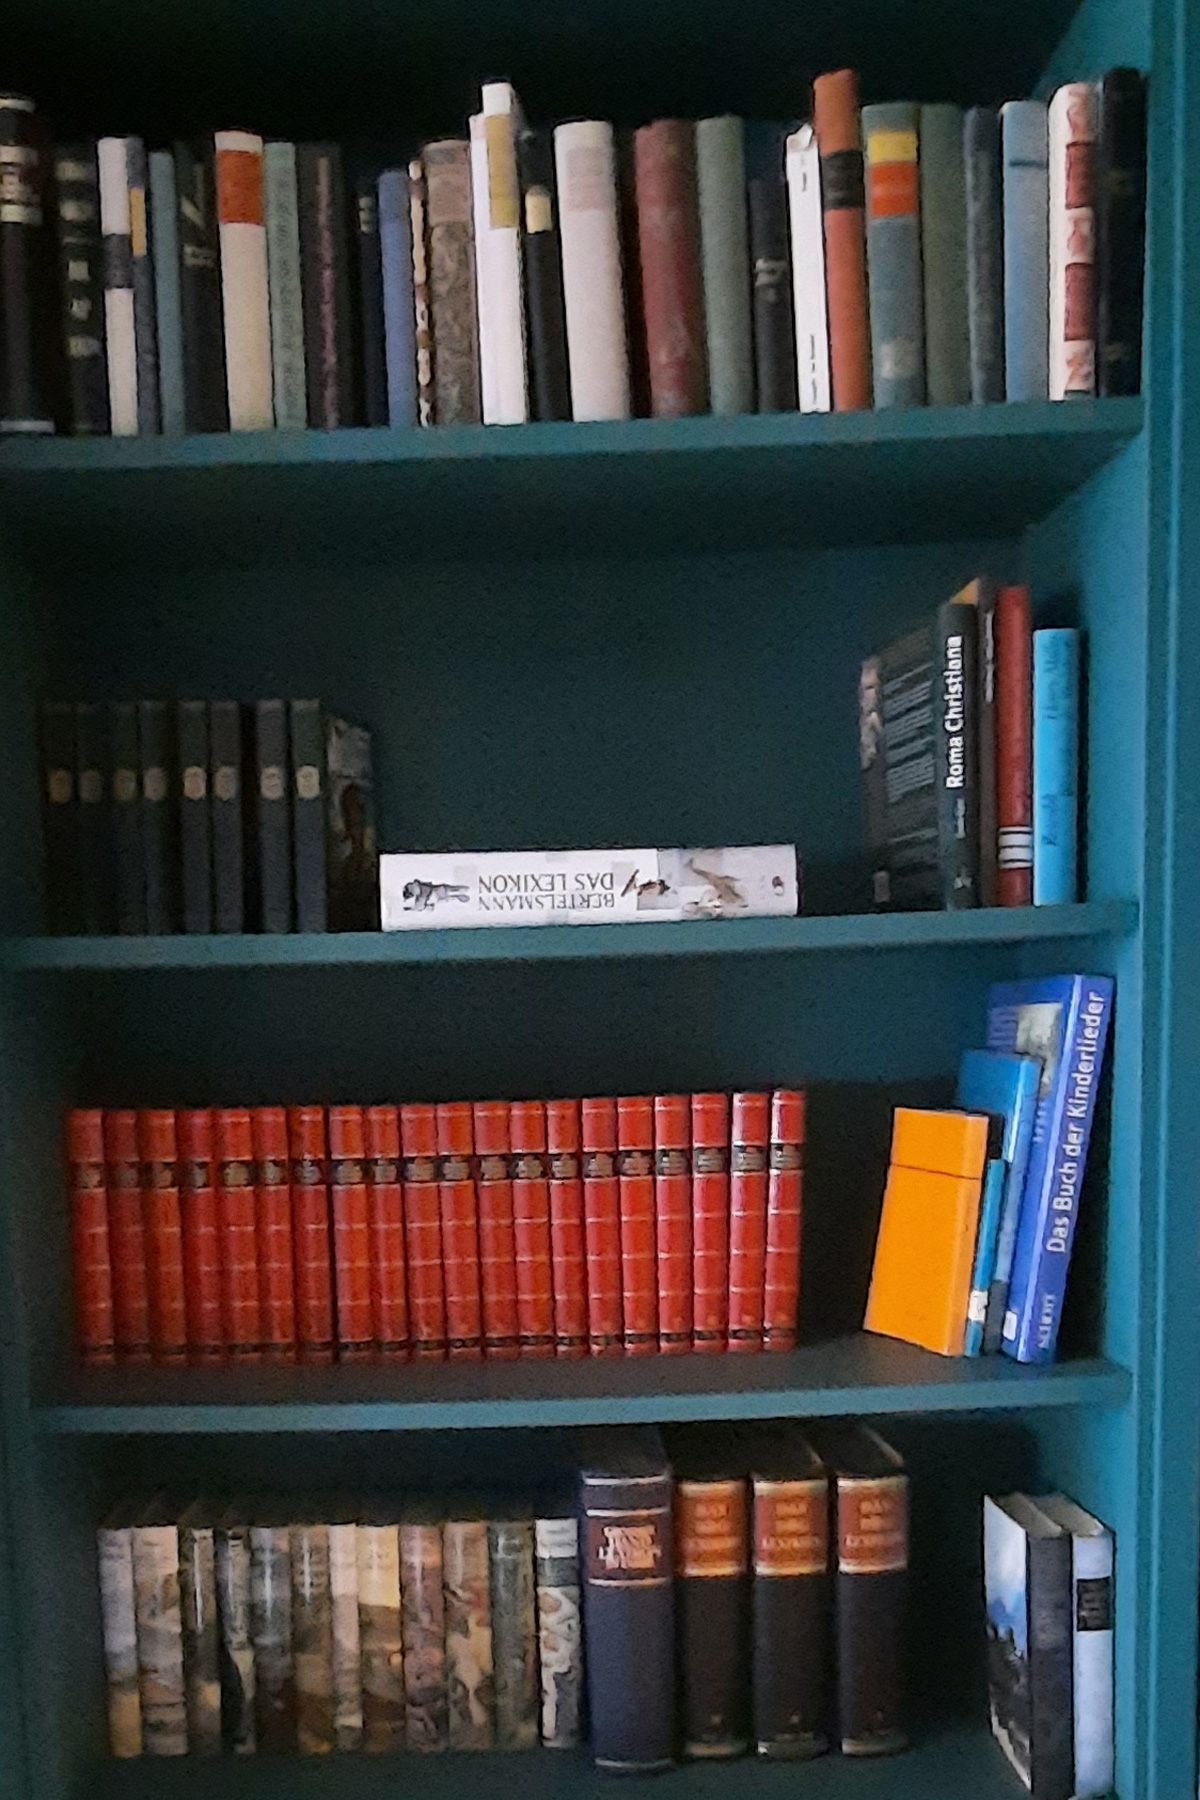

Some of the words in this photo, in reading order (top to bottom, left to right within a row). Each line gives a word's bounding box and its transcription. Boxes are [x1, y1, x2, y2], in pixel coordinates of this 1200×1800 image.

[943, 636, 964, 732] Christiana
[946, 735, 964, 789] Roma
[478, 874, 567, 894] LEXIKON
[574, 872, 614, 891] DAS
[478, 893, 615, 911] BERTELSMANN
[1066, 991, 1105, 1119] Kinderlieder
[1062, 1121, 1085, 1156] der
[1052, 1162, 1078, 1212] Buch
[1046, 1216, 1071, 1253] Das
